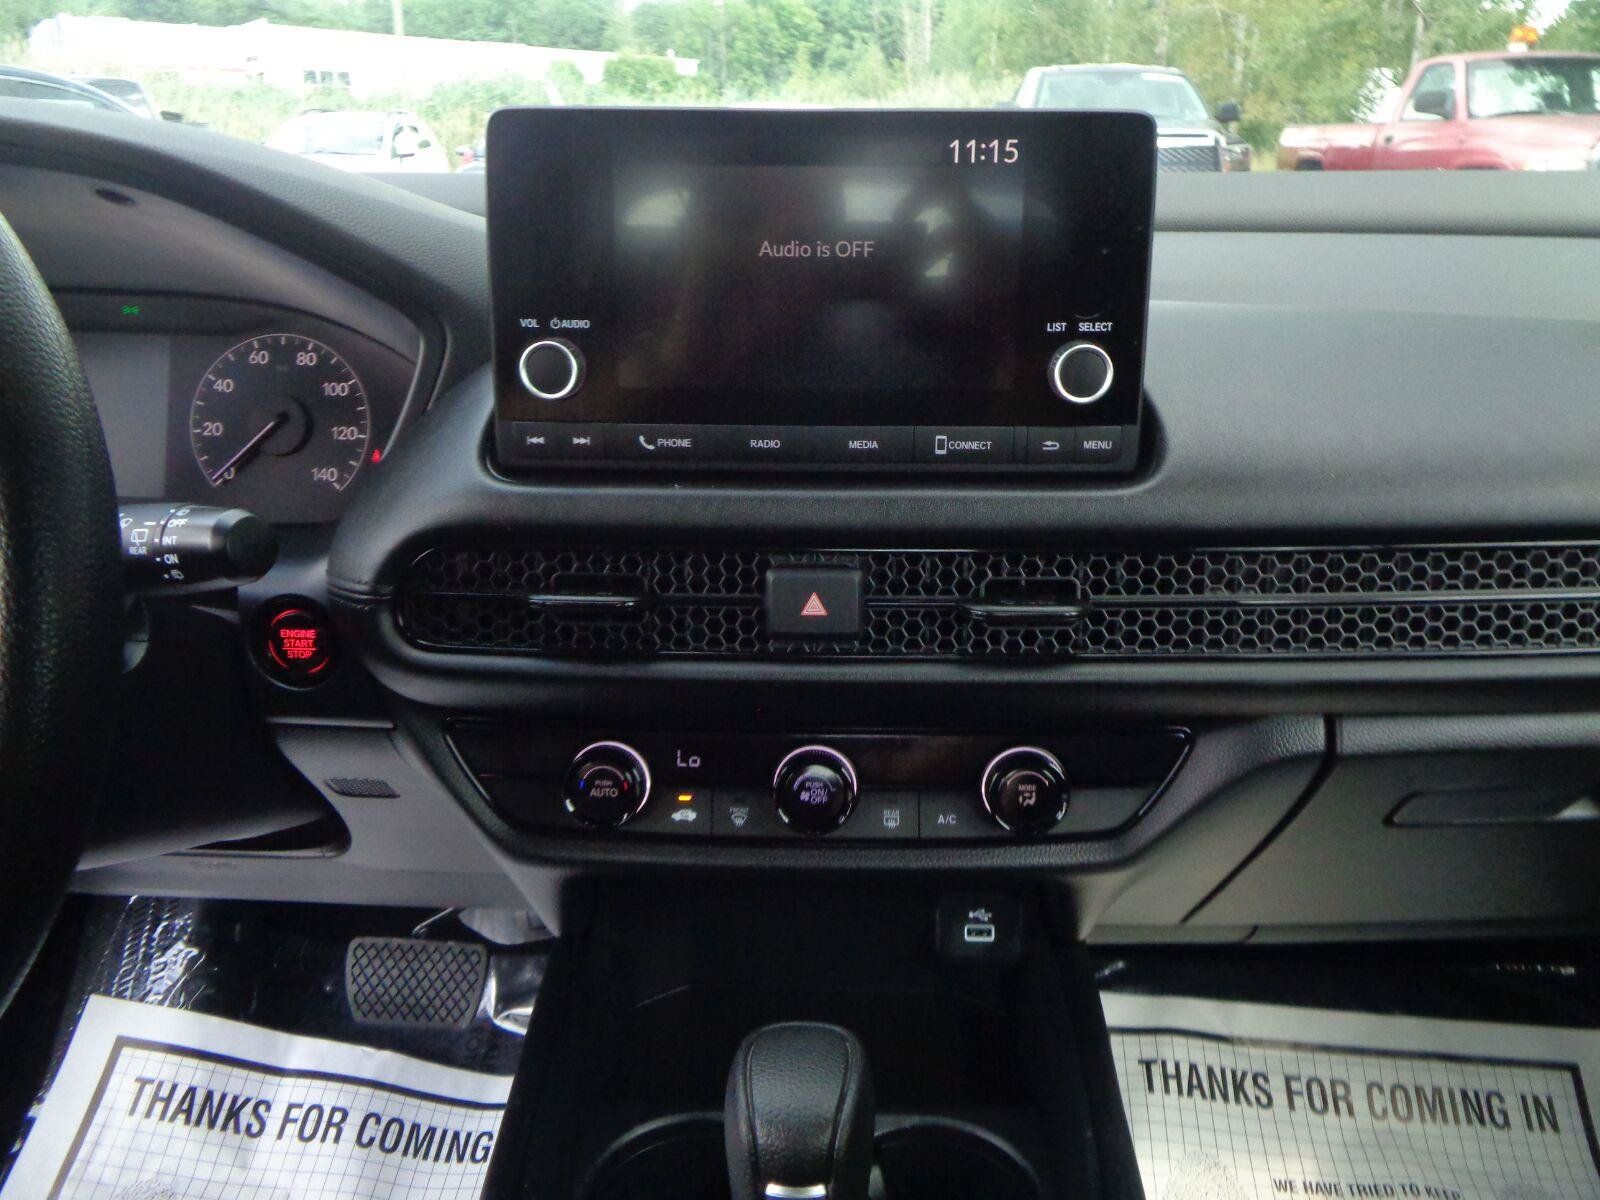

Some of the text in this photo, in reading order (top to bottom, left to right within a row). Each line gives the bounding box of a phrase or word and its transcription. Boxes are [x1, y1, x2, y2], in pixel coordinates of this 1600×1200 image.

[950, 138, 1020, 164] 11:15
[758, 240, 875, 258] Audio is OFF
[519, 318, 540, 329] VOL
[561, 319, 591, 329] AUDIO
[1046, 322, 1067, 333] LIST
[1078, 322, 1114, 333] SELECT
[249, 350, 269, 365] 60
[296, 352, 318, 366] 80
[212, 378, 235, 393] 40
[321, 382, 350, 397] 100
[202, 422, 224, 436] 20
[331, 426, 359, 440] 120
[657, 438, 693, 448] PHONE
[749, 439, 781, 449] RADIO
[848, 440, 879, 450] MEDIA
[948, 440, 992, 451] CONNECT
[1082, 440, 1113, 450] MENU
[311, 467, 338, 482] 140
[168, 518, 188, 528] OFF
[162, 535, 177, 546] INT
[129, 546, 148, 555] REAR
[164, 553, 180, 564] ON
[280, 629, 316, 638] ENGINE
[283, 638, 314, 648] START
[287, 650, 312, 658] STOP
[676, 749, 701, 768] Lo
[590, 788, 619, 798] AUTO
[810, 796, 829, 804] OFF
[937, 813, 958, 825] A/C
[1137, 1058, 1562, 1135] THANKS FOR COMING IN
[126, 1077, 495, 1165] THANKS FOR COMING
[1272, 1177, 1299, 1194] WE
[1302, 1179, 1344, 1198] HAVE
[1345, 1183, 1395, 1199] TRIED
[1399, 1182, 1422, 1199] TO
